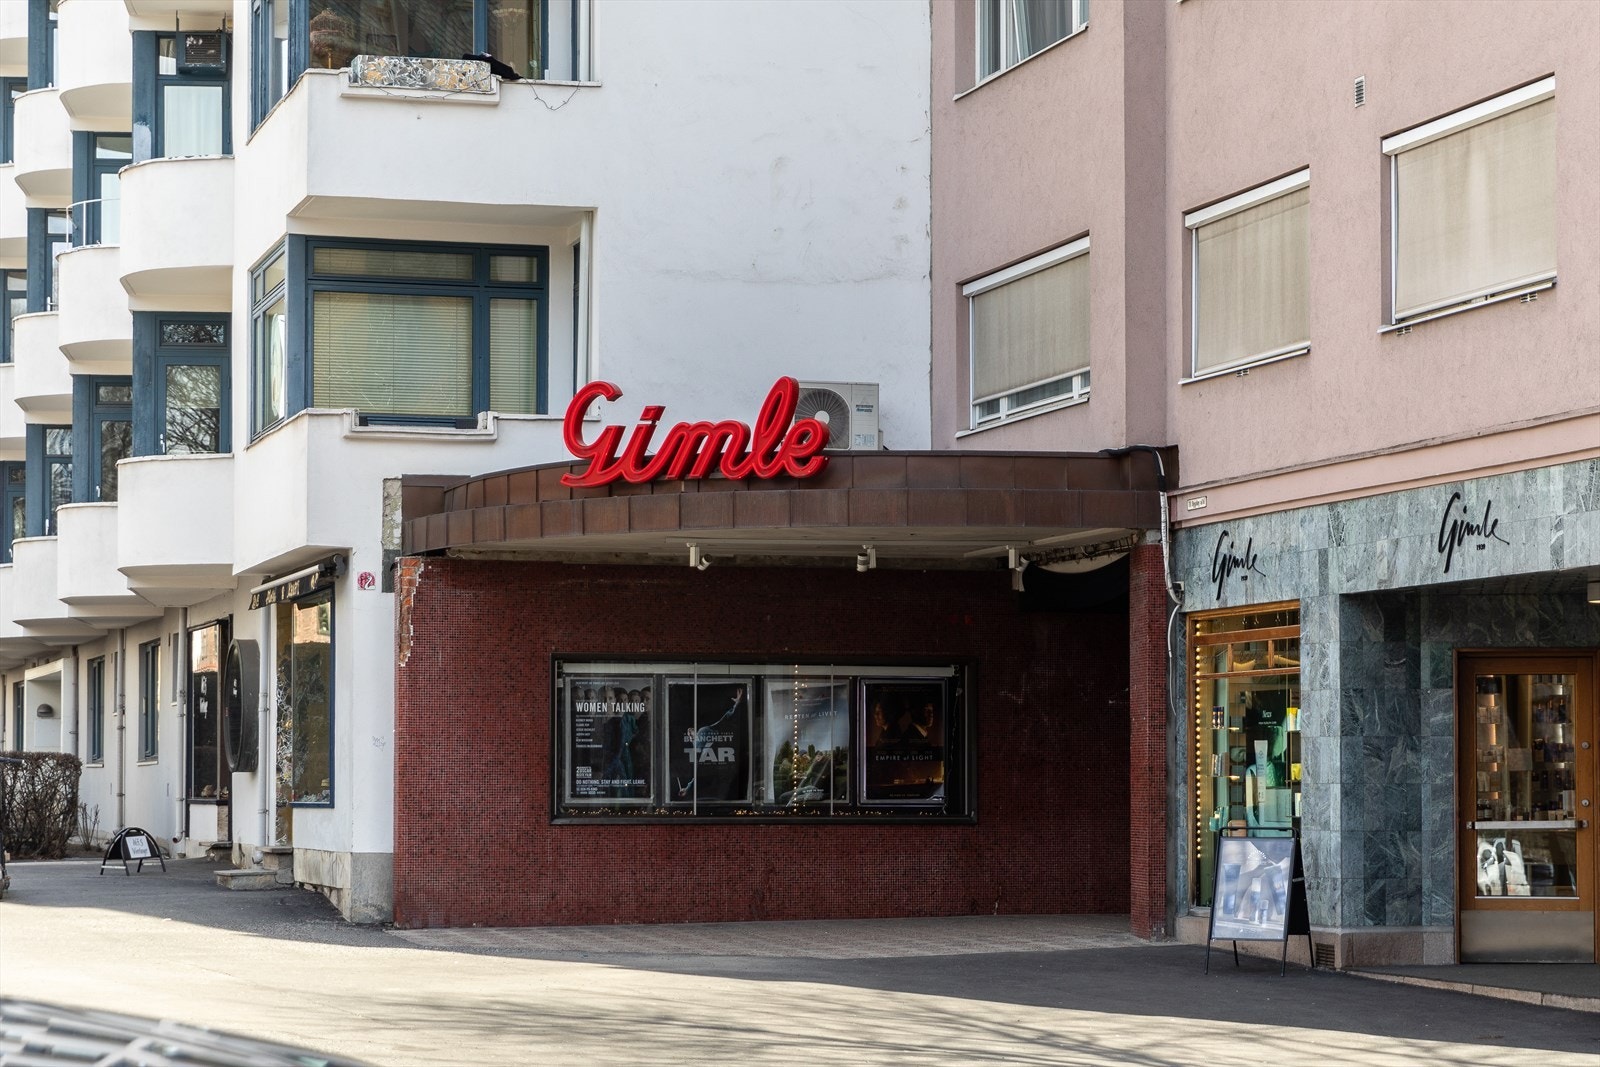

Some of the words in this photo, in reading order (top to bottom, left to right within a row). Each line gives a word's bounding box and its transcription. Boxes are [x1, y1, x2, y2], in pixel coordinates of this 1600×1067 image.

[560, 376, 831, 487] Gimle
[1212, 530, 1266, 600] Gimle
[1438, 492, 1510, 573] Gimle
[576, 702, 608, 712] WOMEN
[611, 702, 645, 712] TALKING
[683, 742, 736, 762] TÁR
